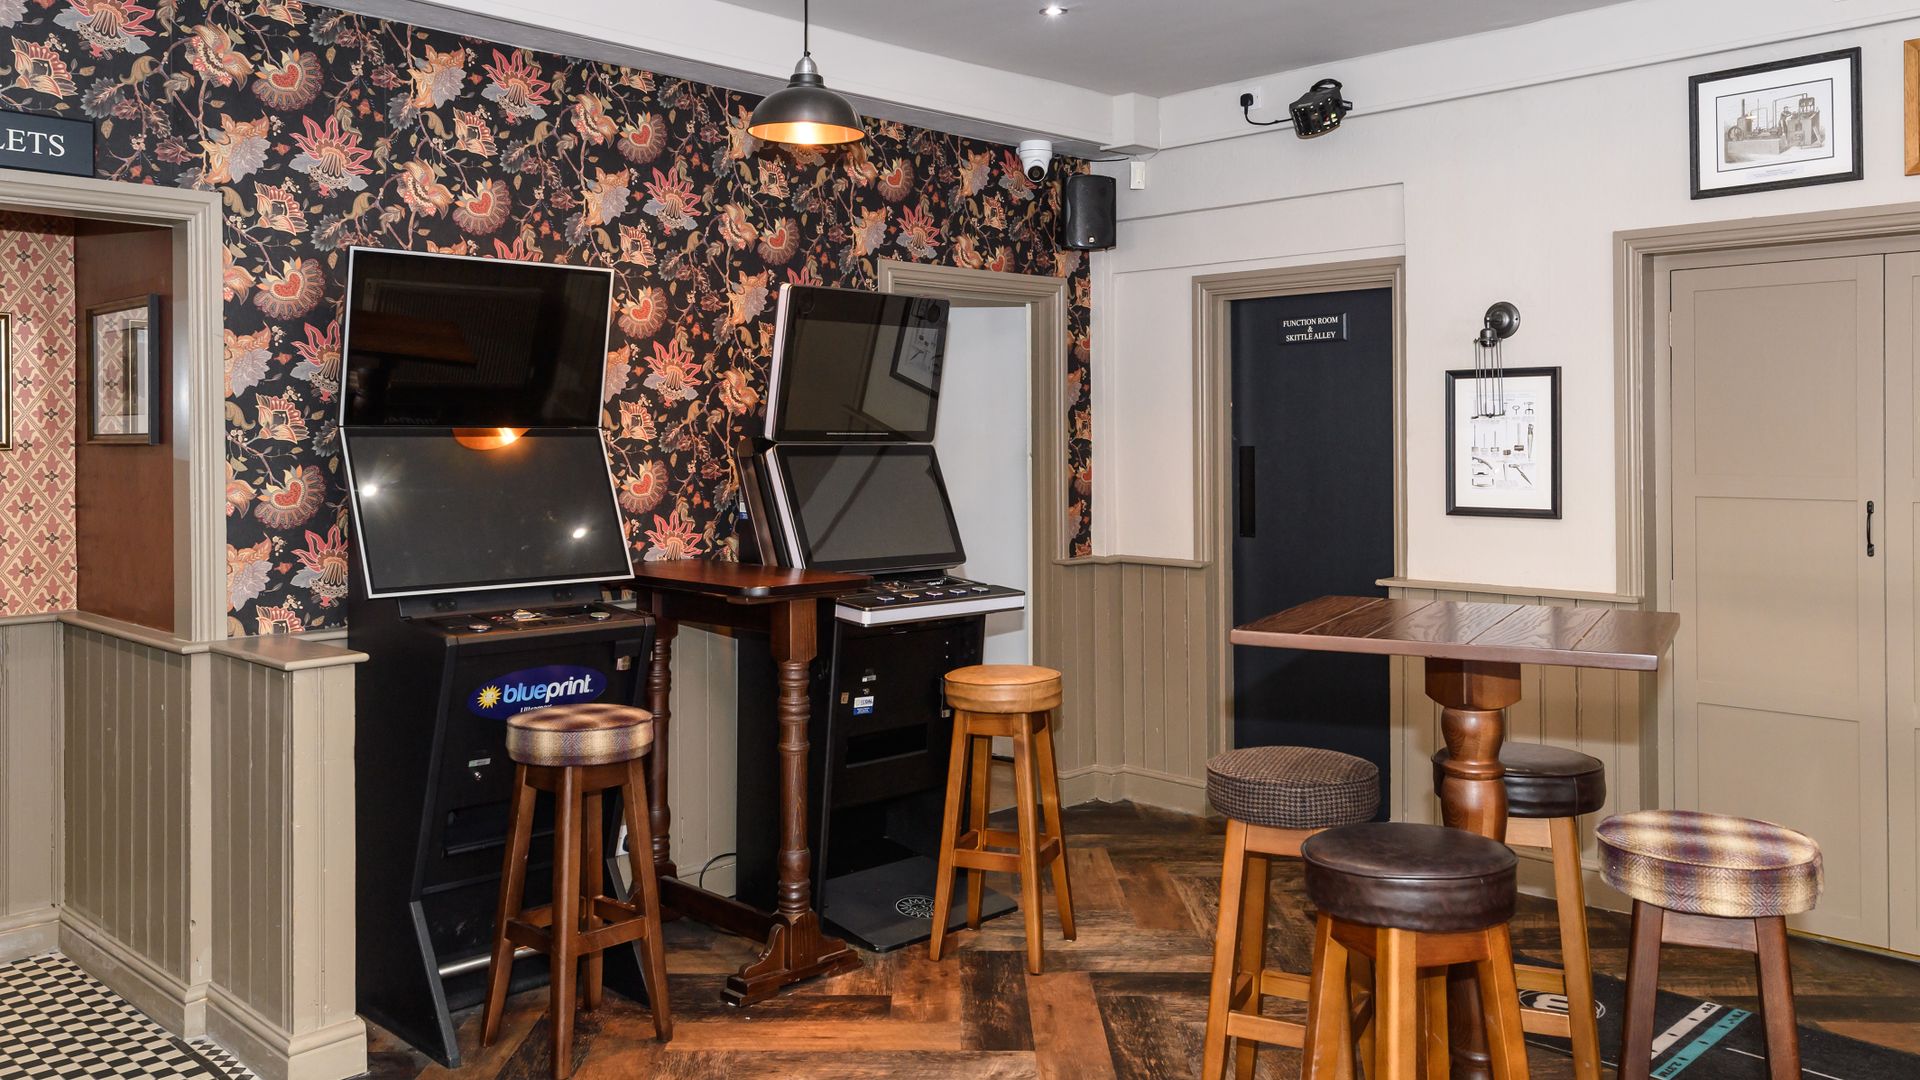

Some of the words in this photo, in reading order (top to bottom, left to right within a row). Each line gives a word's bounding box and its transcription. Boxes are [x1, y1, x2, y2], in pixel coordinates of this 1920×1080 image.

[1283, 319, 1317, 327] FUNCTION
[1318, 316, 1338, 325] ROOM
[1285, 333, 1313, 342] SKITTLE
[1313, 331, 1336, 340] ALLEY
[503, 674, 592, 703] blueprint
